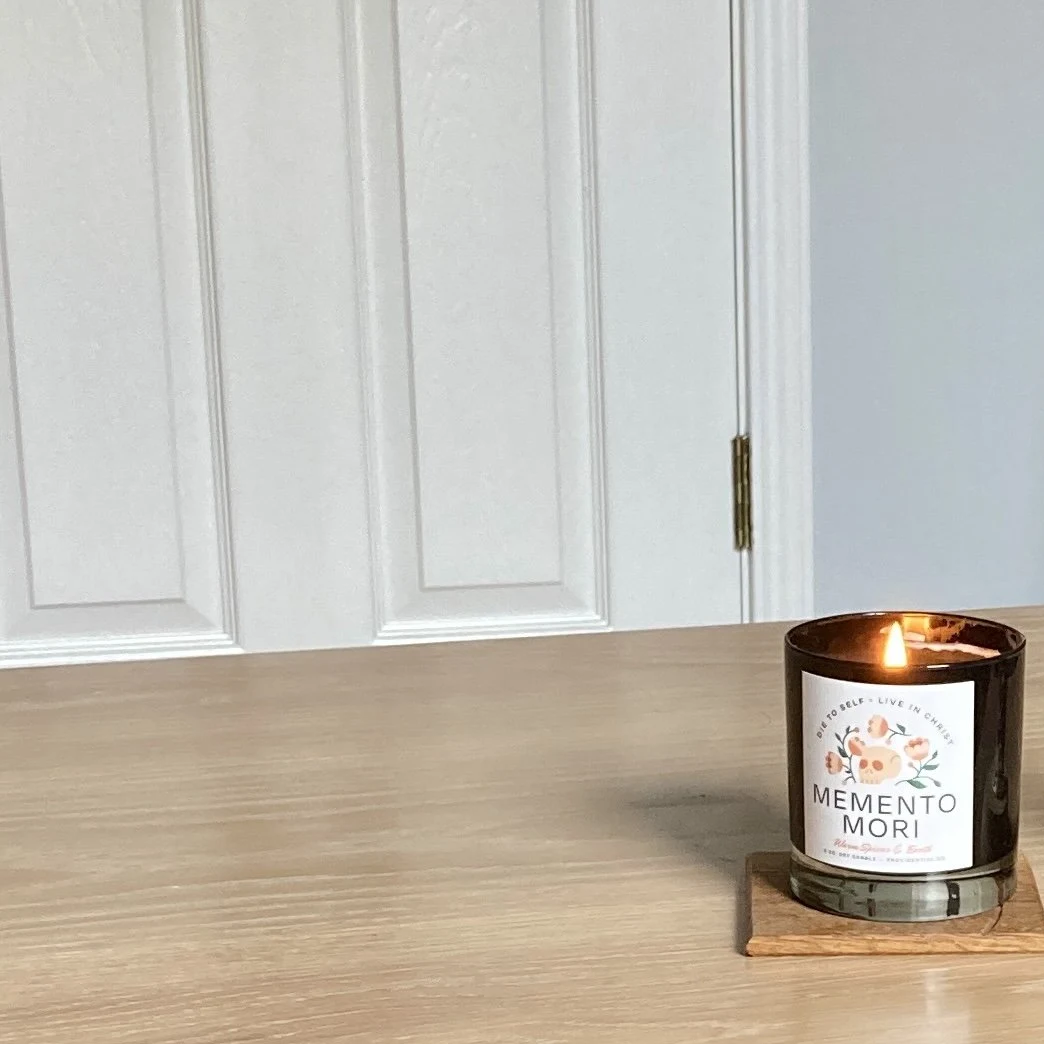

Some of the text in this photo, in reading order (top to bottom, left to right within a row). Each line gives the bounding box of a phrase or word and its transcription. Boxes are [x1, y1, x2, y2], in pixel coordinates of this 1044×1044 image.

[816, 697, 955, 745] DIE TO SELF LIVE IN CHRIST
[813, 783, 957, 815] MEMENTO
[843, 814, 918, 838] MORI
